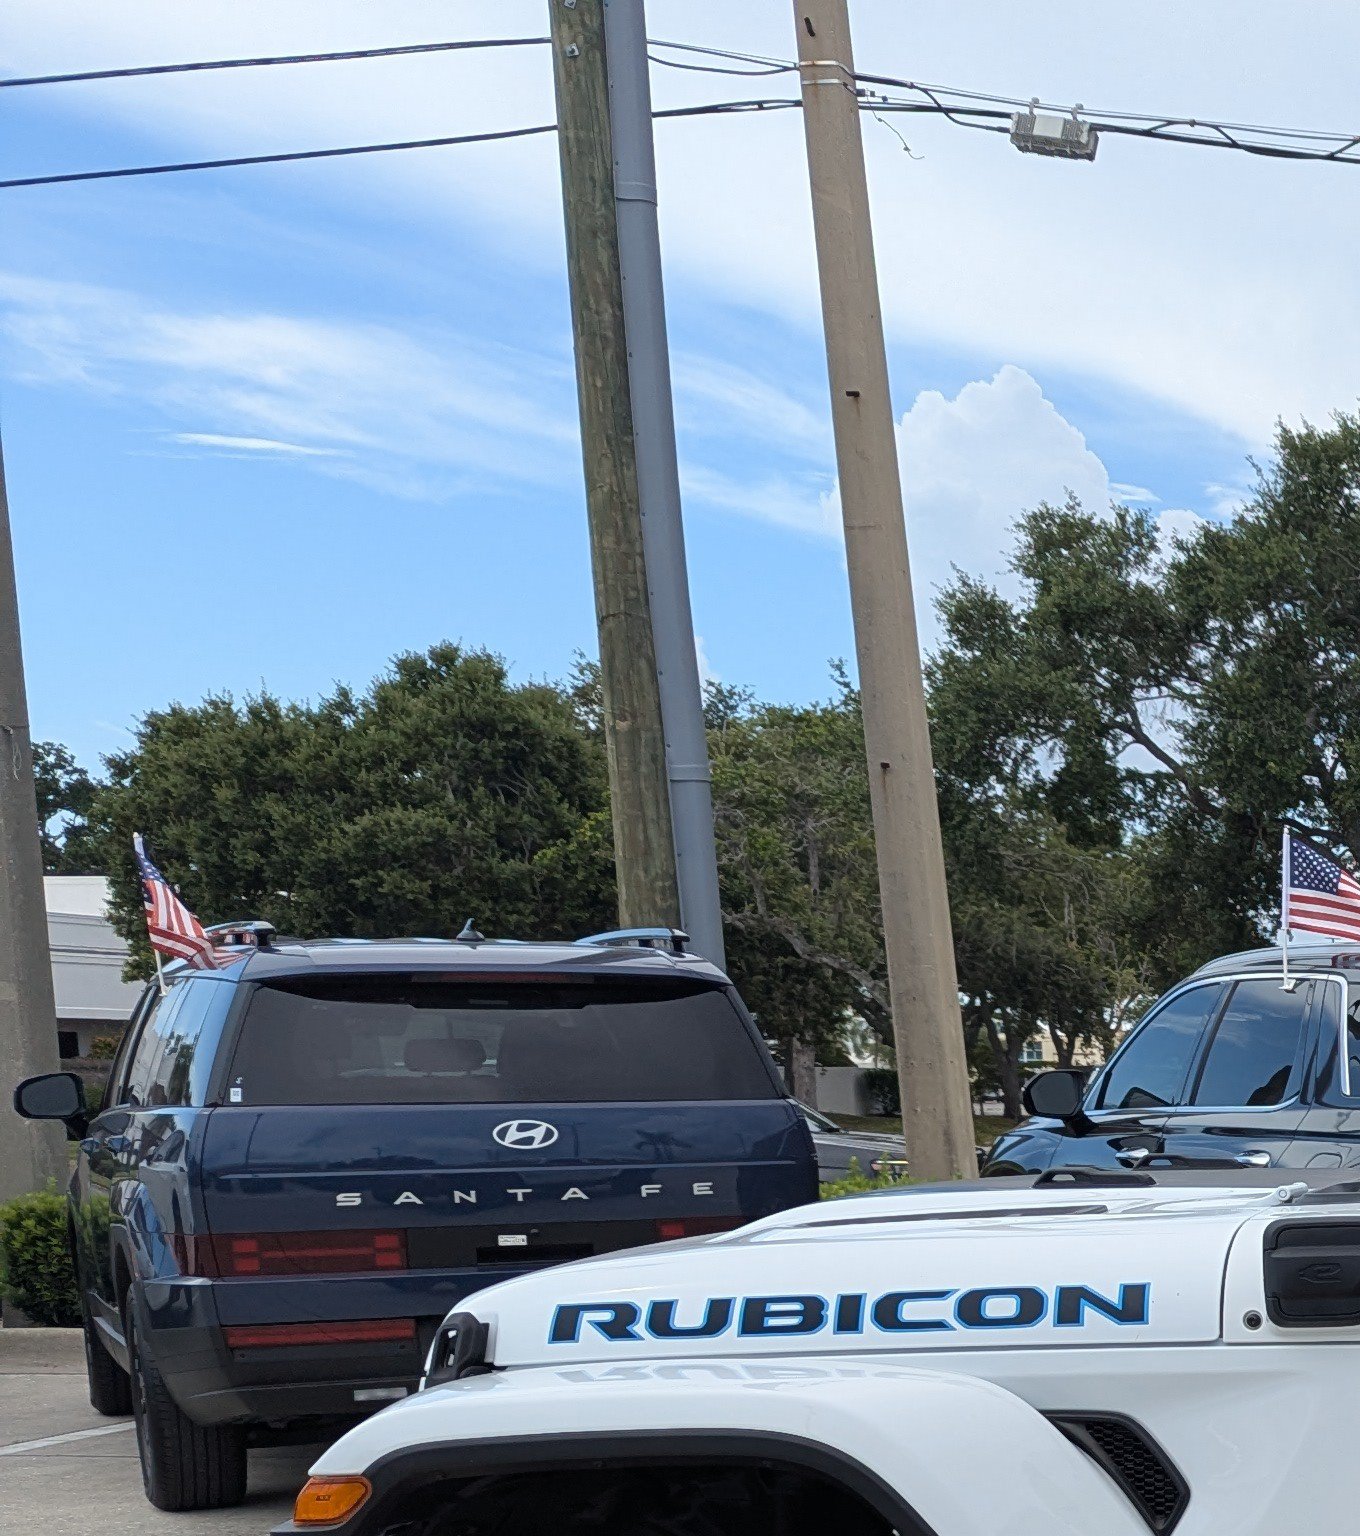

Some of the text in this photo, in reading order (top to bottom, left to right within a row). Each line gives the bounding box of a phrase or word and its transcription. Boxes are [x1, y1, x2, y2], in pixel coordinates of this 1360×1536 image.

[335, 1181, 714, 1207] SANTA FE
[547, 1282, 1152, 1344] RUBICON
